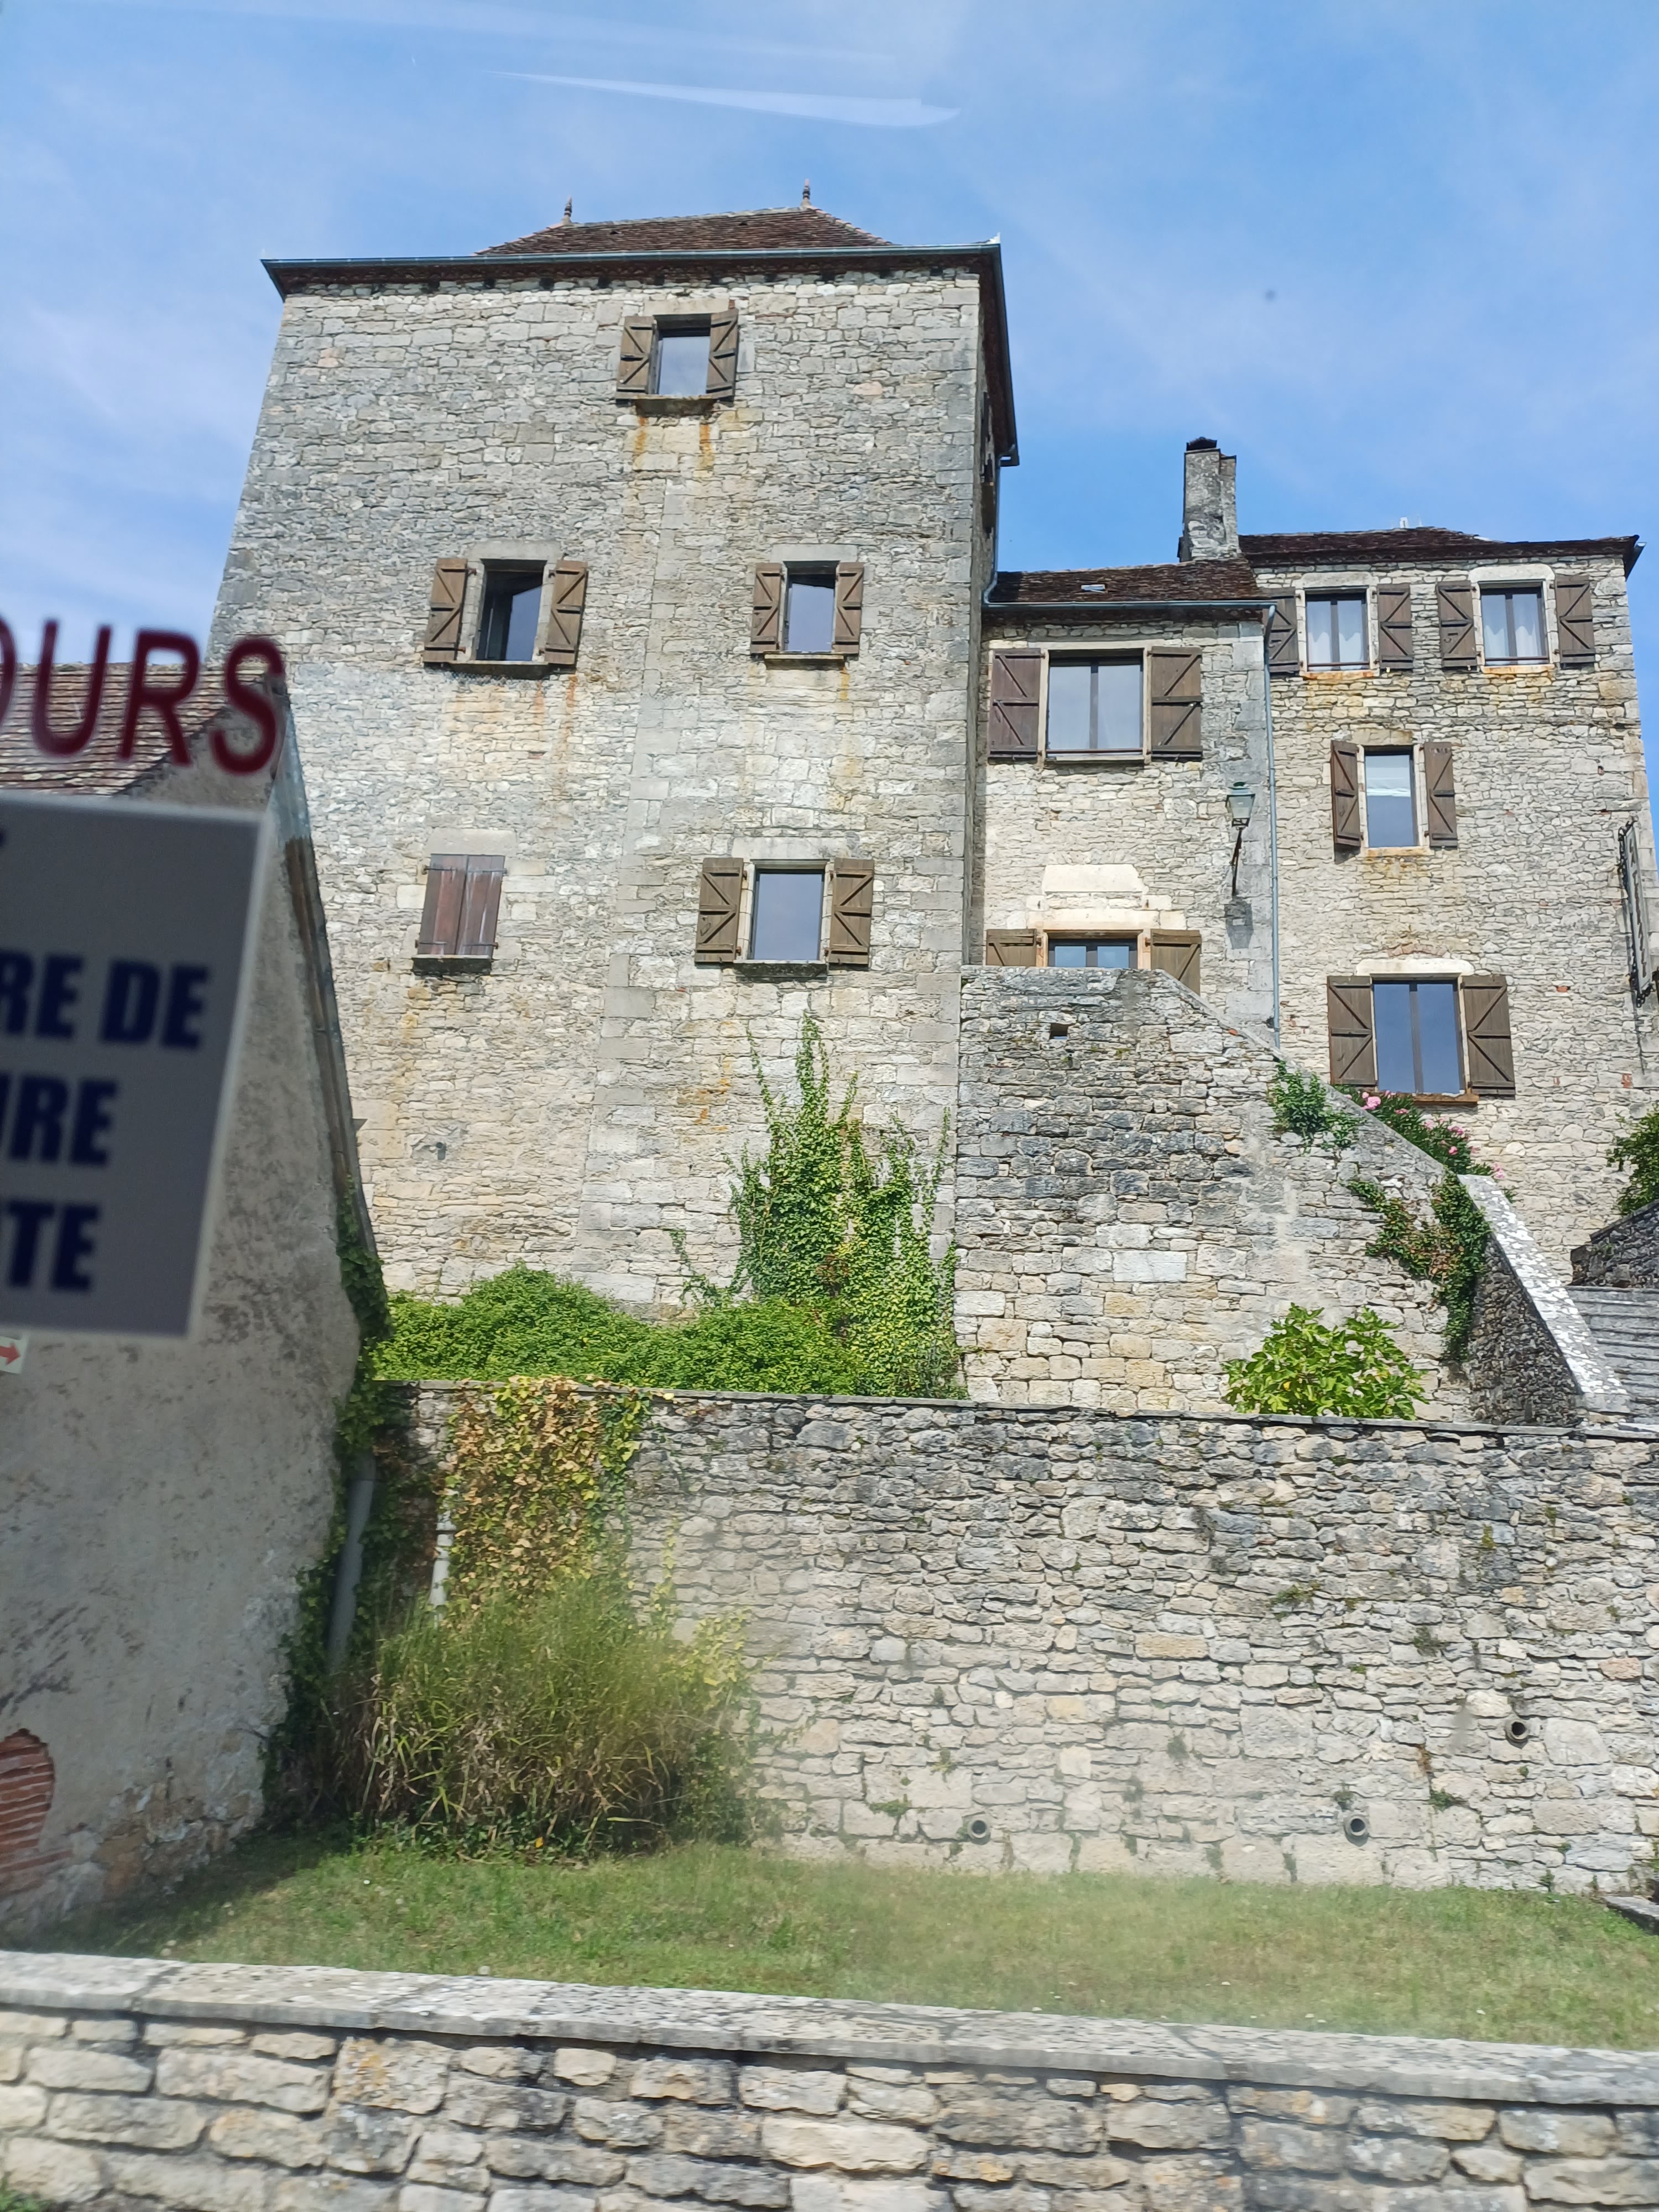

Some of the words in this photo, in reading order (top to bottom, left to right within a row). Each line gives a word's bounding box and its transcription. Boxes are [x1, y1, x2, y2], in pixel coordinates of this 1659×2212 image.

[100, 958, 209, 1050] DE
[0, 1072, 117, 1166] RE
[6, 1199, 100, 1292] TE
